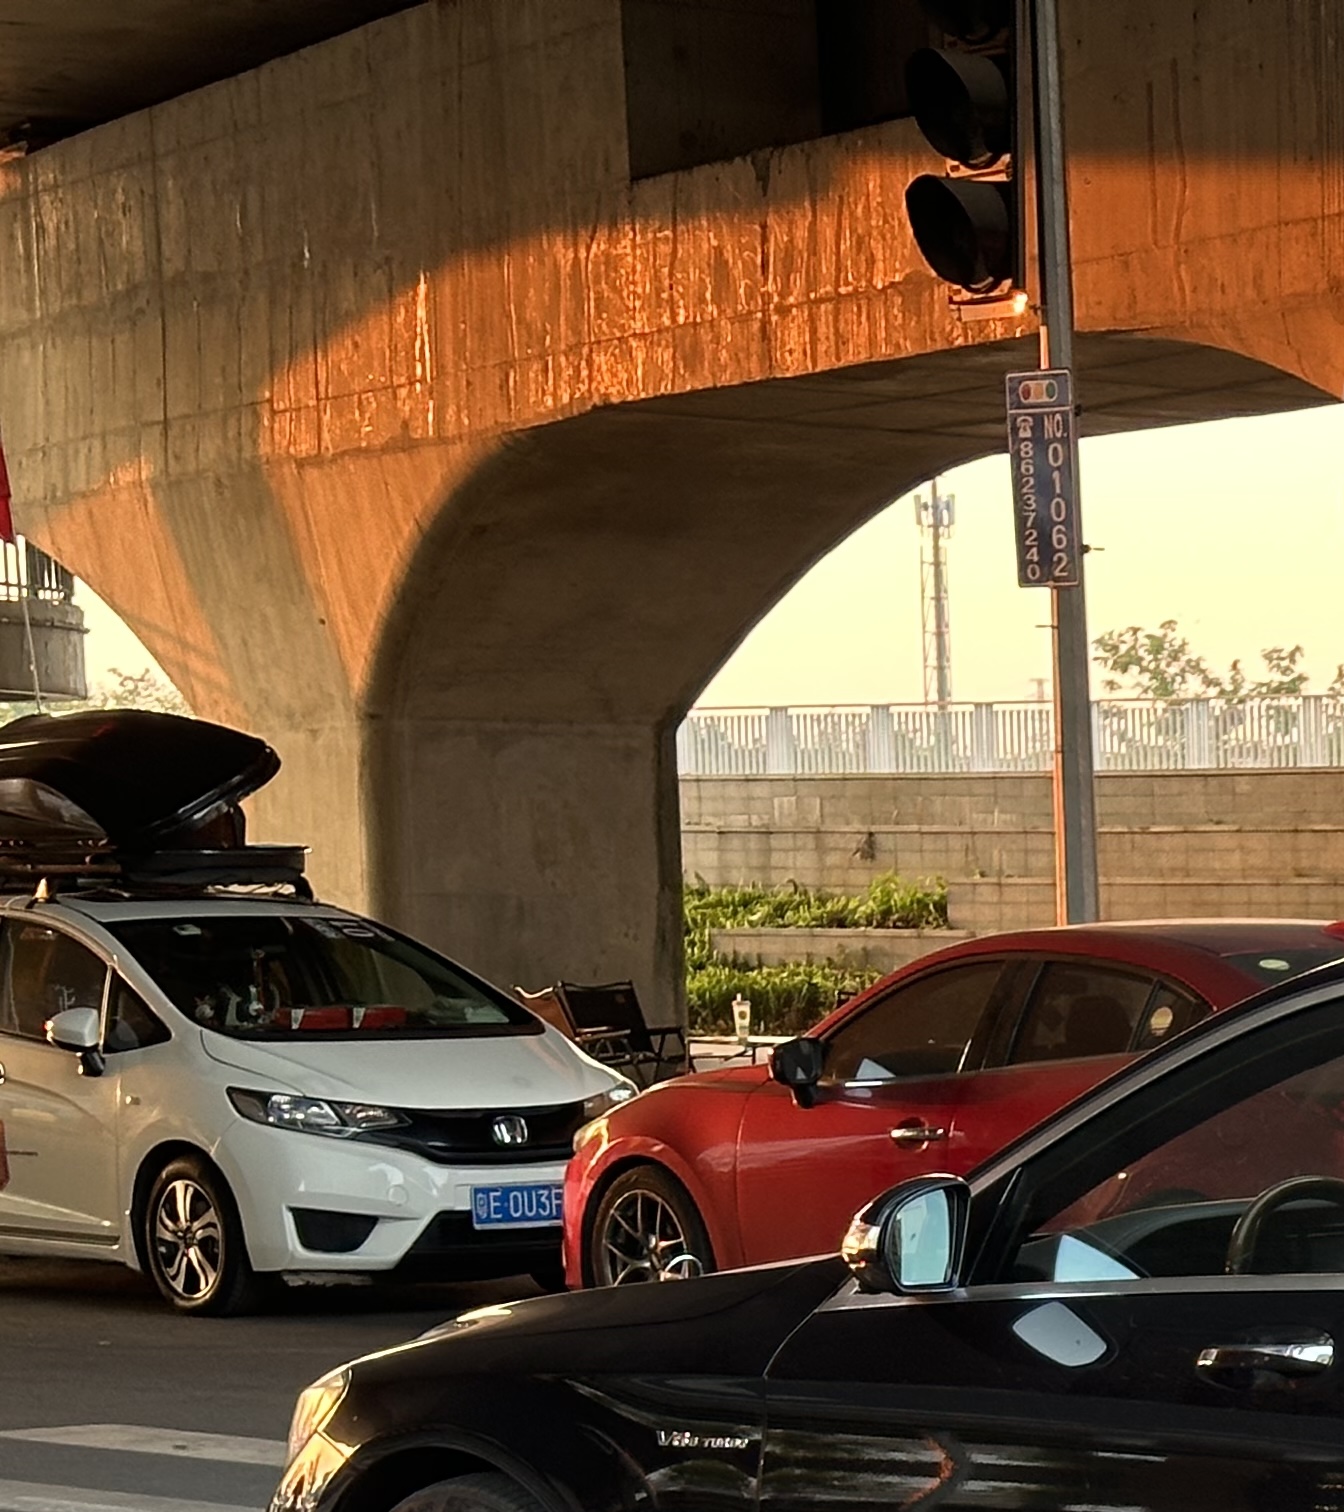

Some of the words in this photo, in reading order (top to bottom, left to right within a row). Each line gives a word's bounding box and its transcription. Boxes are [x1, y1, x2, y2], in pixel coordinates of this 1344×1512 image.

[1043, 412, 1068, 439] NO.
[1018, 441, 1041, 581] 86237240
[1048, 443, 1069, 578] 01062
